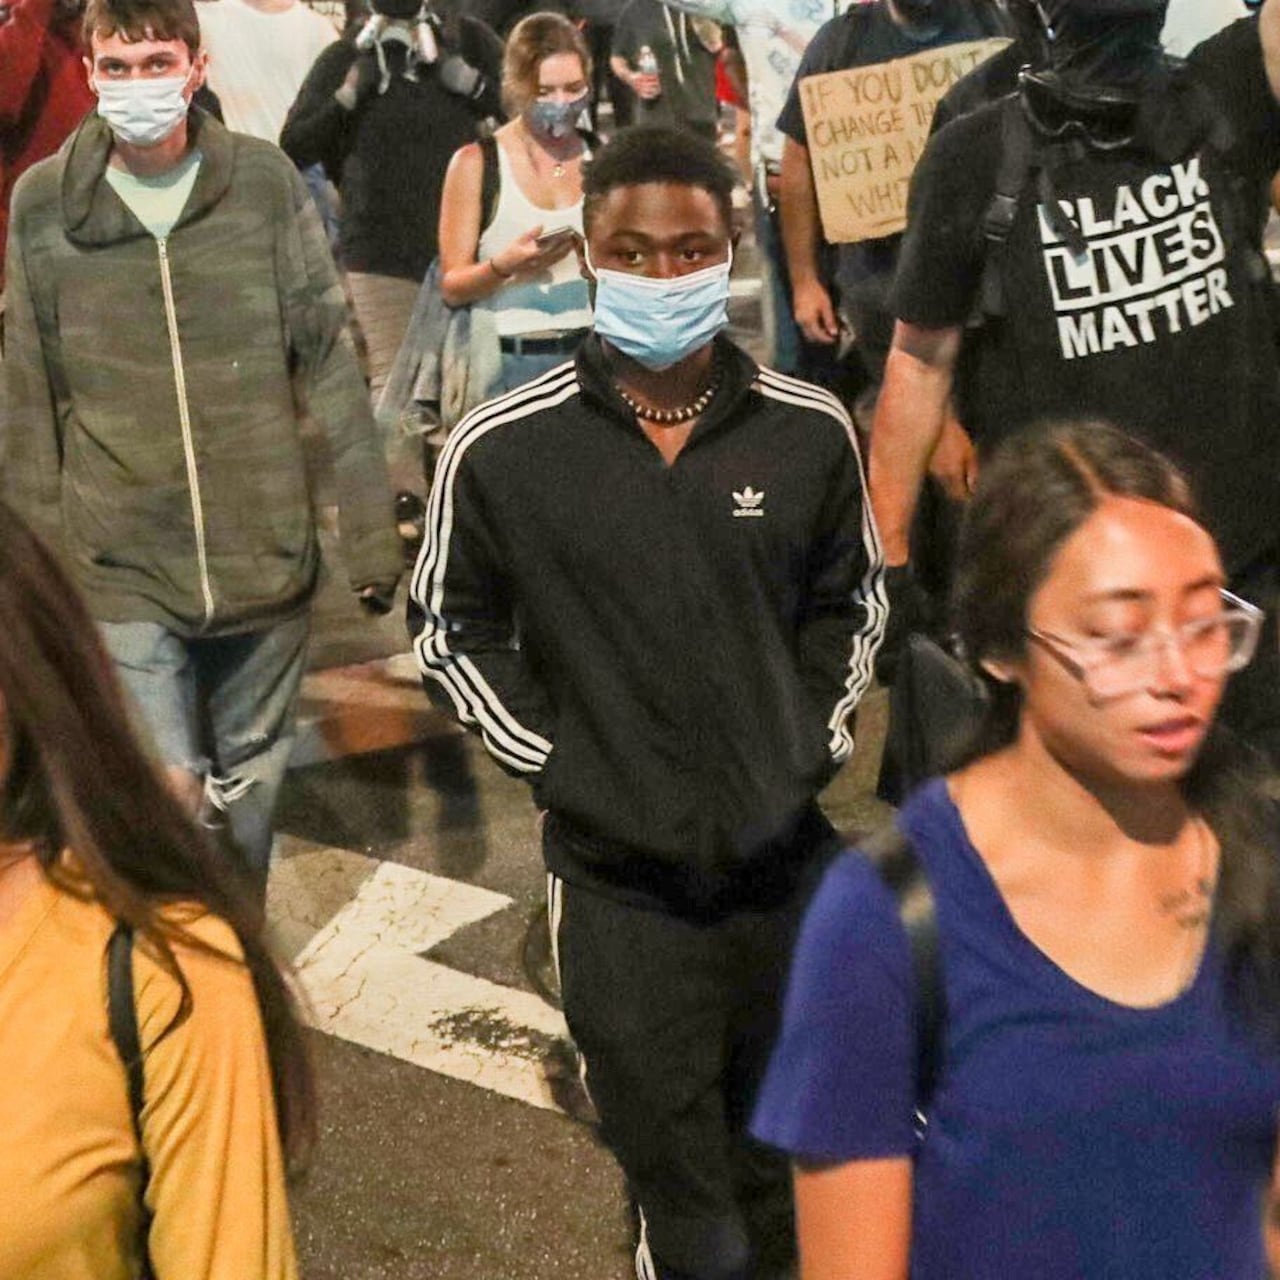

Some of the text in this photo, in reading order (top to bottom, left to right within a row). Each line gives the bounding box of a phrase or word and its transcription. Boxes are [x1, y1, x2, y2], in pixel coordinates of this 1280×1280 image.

[805, 78, 833, 118] IF
[842, 71, 904, 106] YOU
[811, 99, 937, 149] CHANGE TH
[820, 147, 874, 183] NOT
[883, 144, 899, 170] A
[1050, 208, 1219, 305] LIVES
[1056, 267, 1235, 361] MATTER
